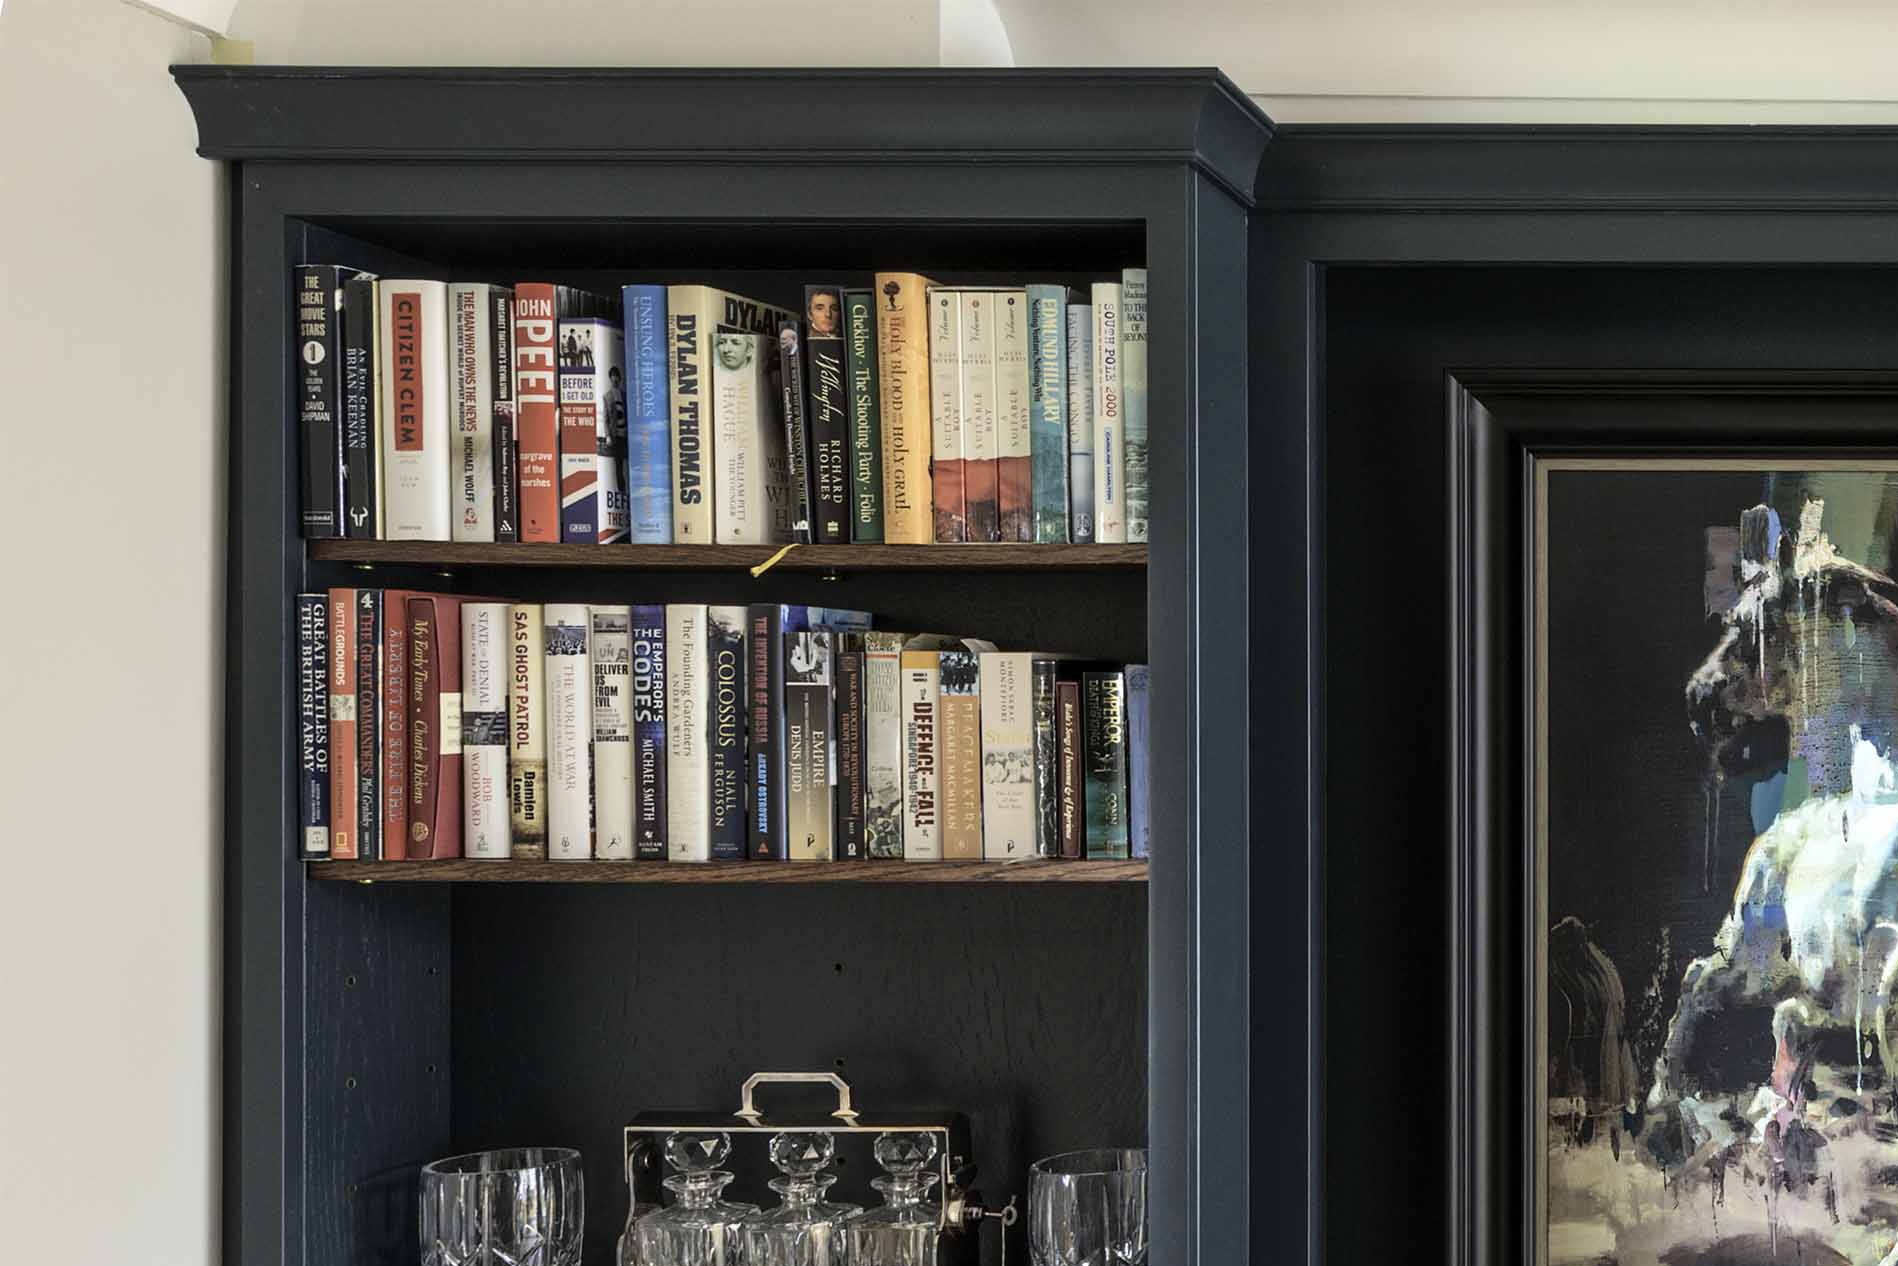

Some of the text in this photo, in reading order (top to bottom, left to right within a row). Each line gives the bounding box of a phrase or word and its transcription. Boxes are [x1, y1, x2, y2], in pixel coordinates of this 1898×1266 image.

[516, 299, 551, 316] JOHN
[346, 348, 359, 449] BRIAN KEENAN
[397, 300, 414, 445] CITIZEN CLEM
[517, 319, 554, 413] PEEL
[562, 378, 592, 390] BEFORE
[675, 314, 701, 505] DYLAN THOMAS
[853, 304, 875, 522] Chekhov The Shooting Party Folio
[819, 444, 830, 501] HOLMES
[831, 440, 842, 504] RICHARD
[313, 603, 327, 664] GREAT
[335, 603, 345, 685] BATTLEGROUNDS
[595, 664, 628, 675] DELIVER
[634, 629, 662, 637] THE
[302, 605, 314, 772] THE BRITISH ARMY
[314, 669, 327, 743] BATTLES
[515, 612, 529, 749] SAS GHOST PATROL
[595, 675, 605, 686] US
[595, 686, 618, 696] FROM
[595, 697, 610, 707] EVIL
[634, 640, 651, 723] CODES
[653, 643, 663, 722] EMPEROR'S
[718, 651, 736, 746] COLOSSUS
[315, 748, 327, 772] OF
[642, 739, 655, 821] MICHAEL SMITH
[715, 754, 724, 826] FERGUSON
[726, 771, 736, 810] NIALL
